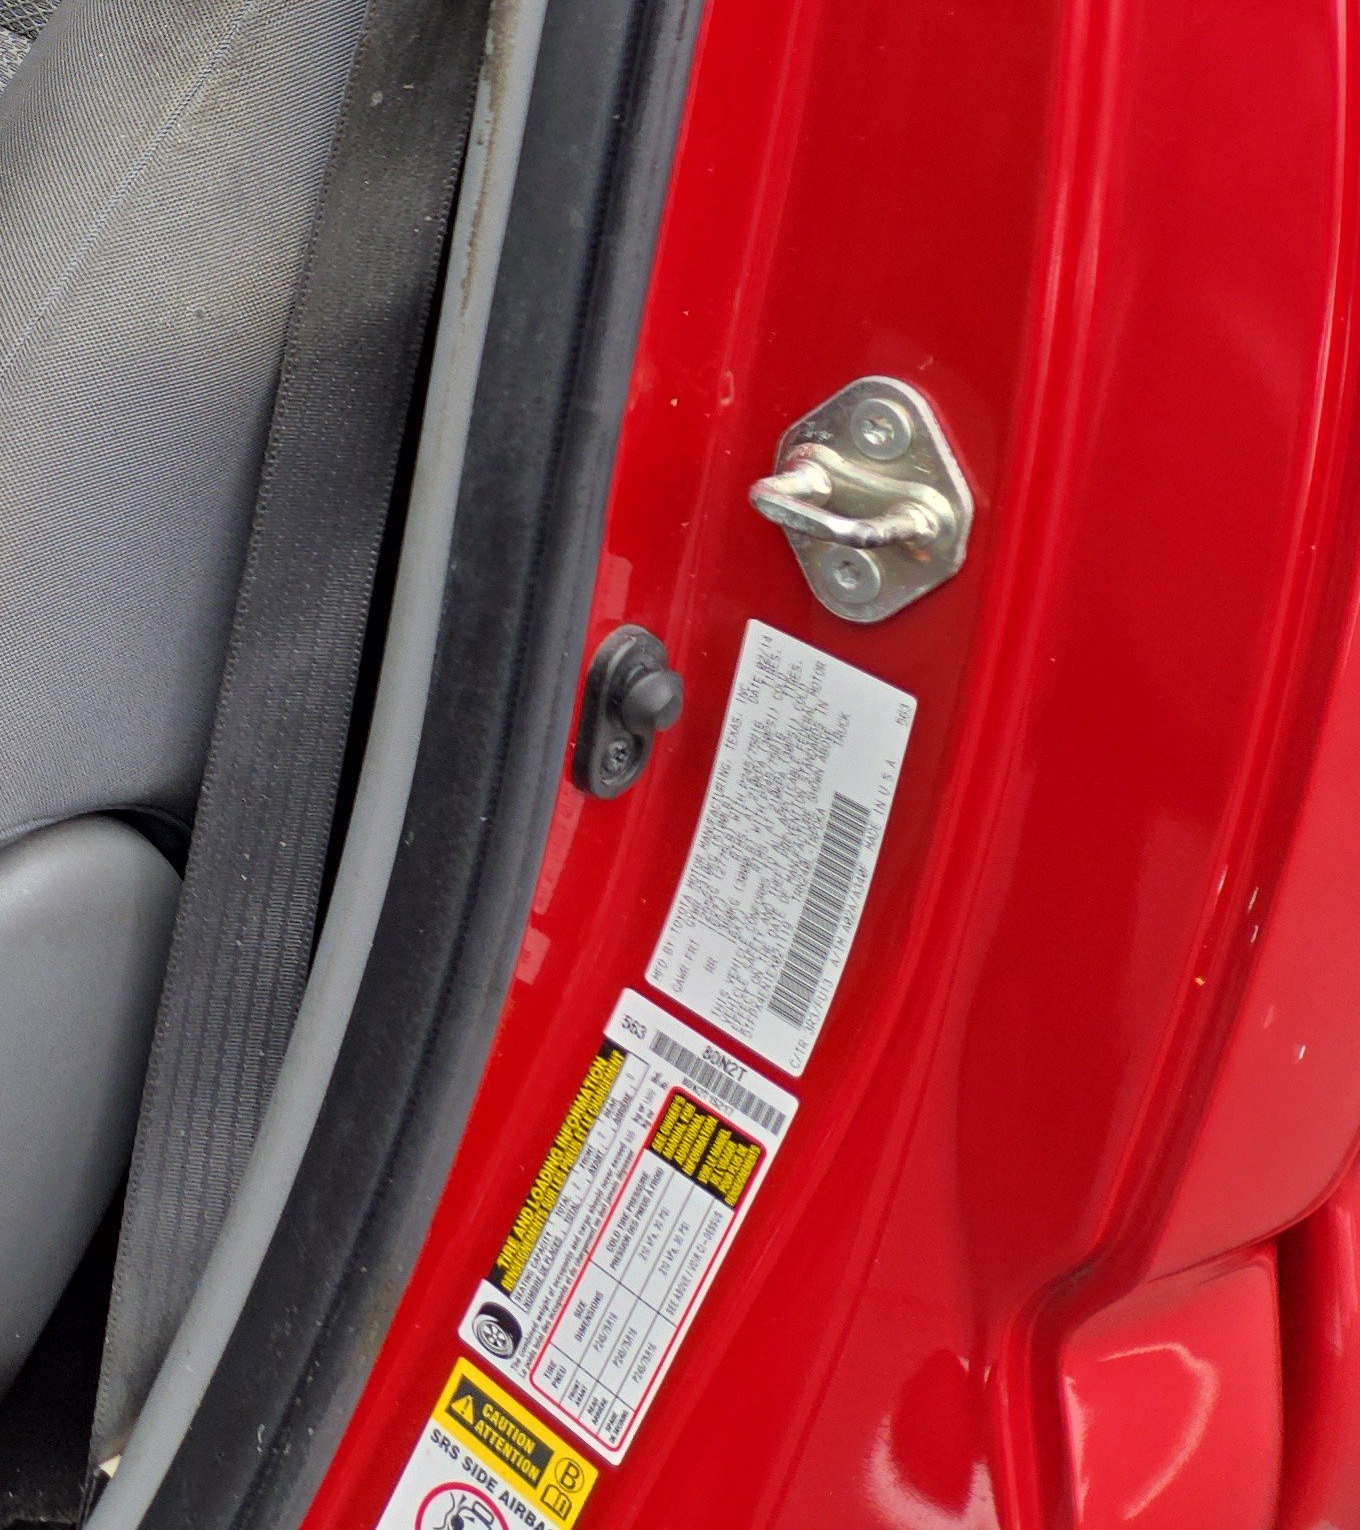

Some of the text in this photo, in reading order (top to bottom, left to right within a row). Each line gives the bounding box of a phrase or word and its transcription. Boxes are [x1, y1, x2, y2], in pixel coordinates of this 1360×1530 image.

[495, 1054, 608, 1271] TIRE AND LOADING INFORMATION
[605, 1229, 621, 1253] COLD
[625, 1170, 650, 1213] PRESSURE
[514, 1231, 552, 1302] SEATING CAPACITY
[573, 1299, 587, 1320] SIZE
[573, 1289, 604, 1343] DIMENSIONS
[543, 1359, 557, 1380] TIRE
[550, 1364, 567, 1390] PNEU
[474, 1420, 540, 1482] ATTENTION
[482, 1403, 536, 1454] CAUTION
[430, 1428, 460, 1460] SRS
[461, 1455, 497, 1494] SIDE
[560, 1461, 578, 1491] B
